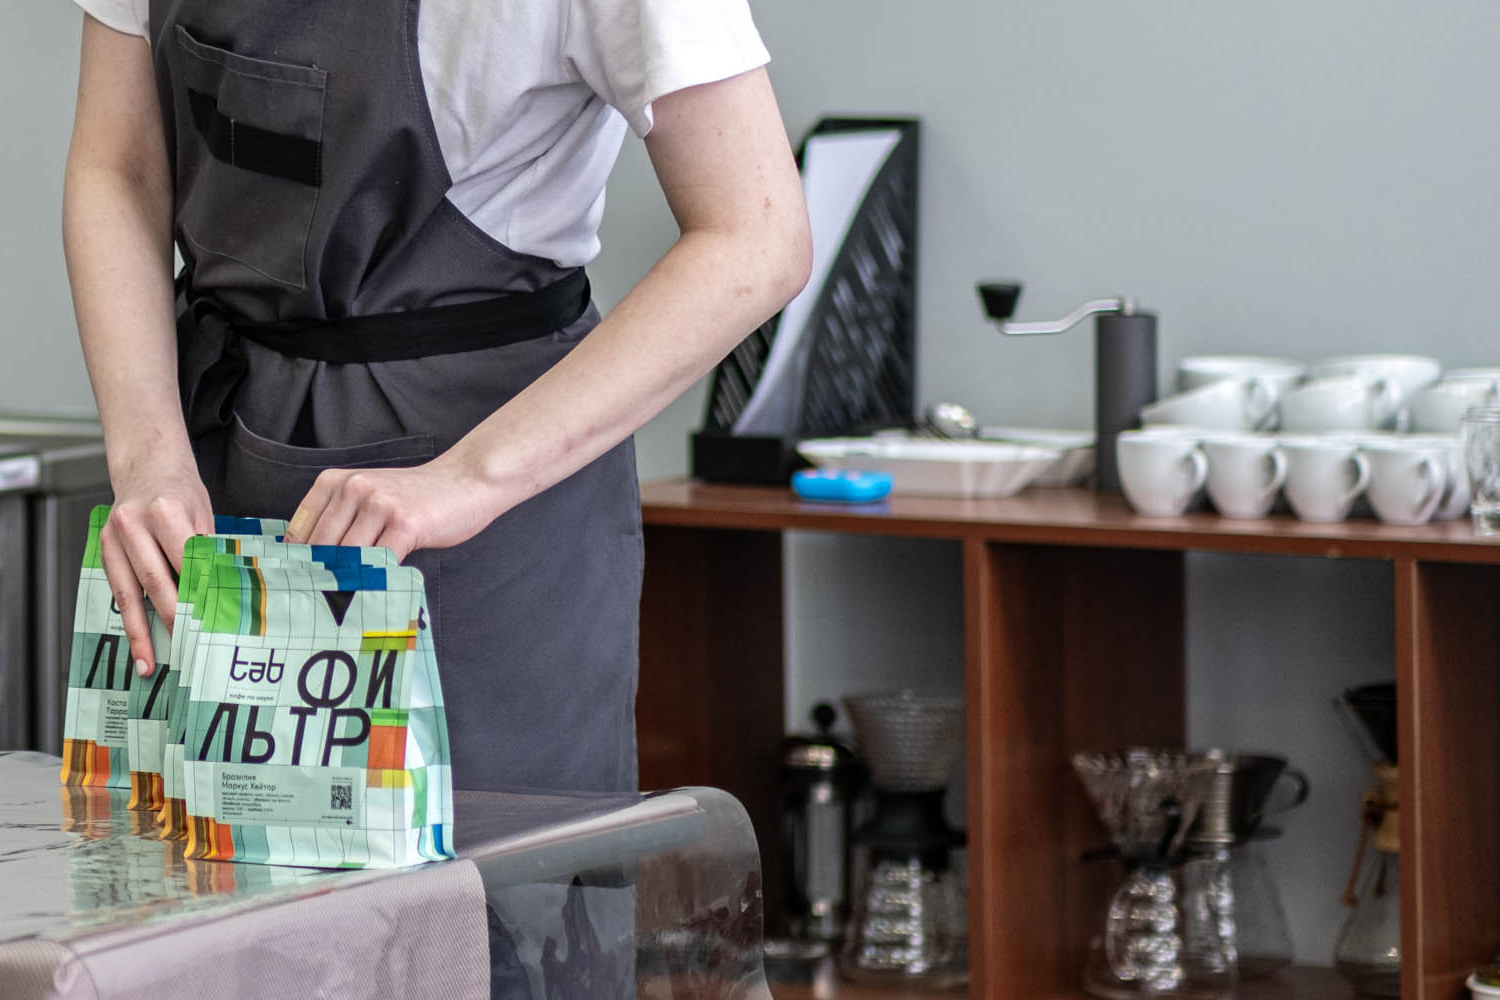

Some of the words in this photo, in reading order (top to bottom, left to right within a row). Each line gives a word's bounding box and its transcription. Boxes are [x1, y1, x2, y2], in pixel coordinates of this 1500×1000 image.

[230, 646, 285, 684] tab
[297, 649, 398, 709] ФИ
[199, 702, 371, 767] ЛЬТР
[221, 772, 256, 781] Бразилия
[221, 781, 248, 791] Маркус
